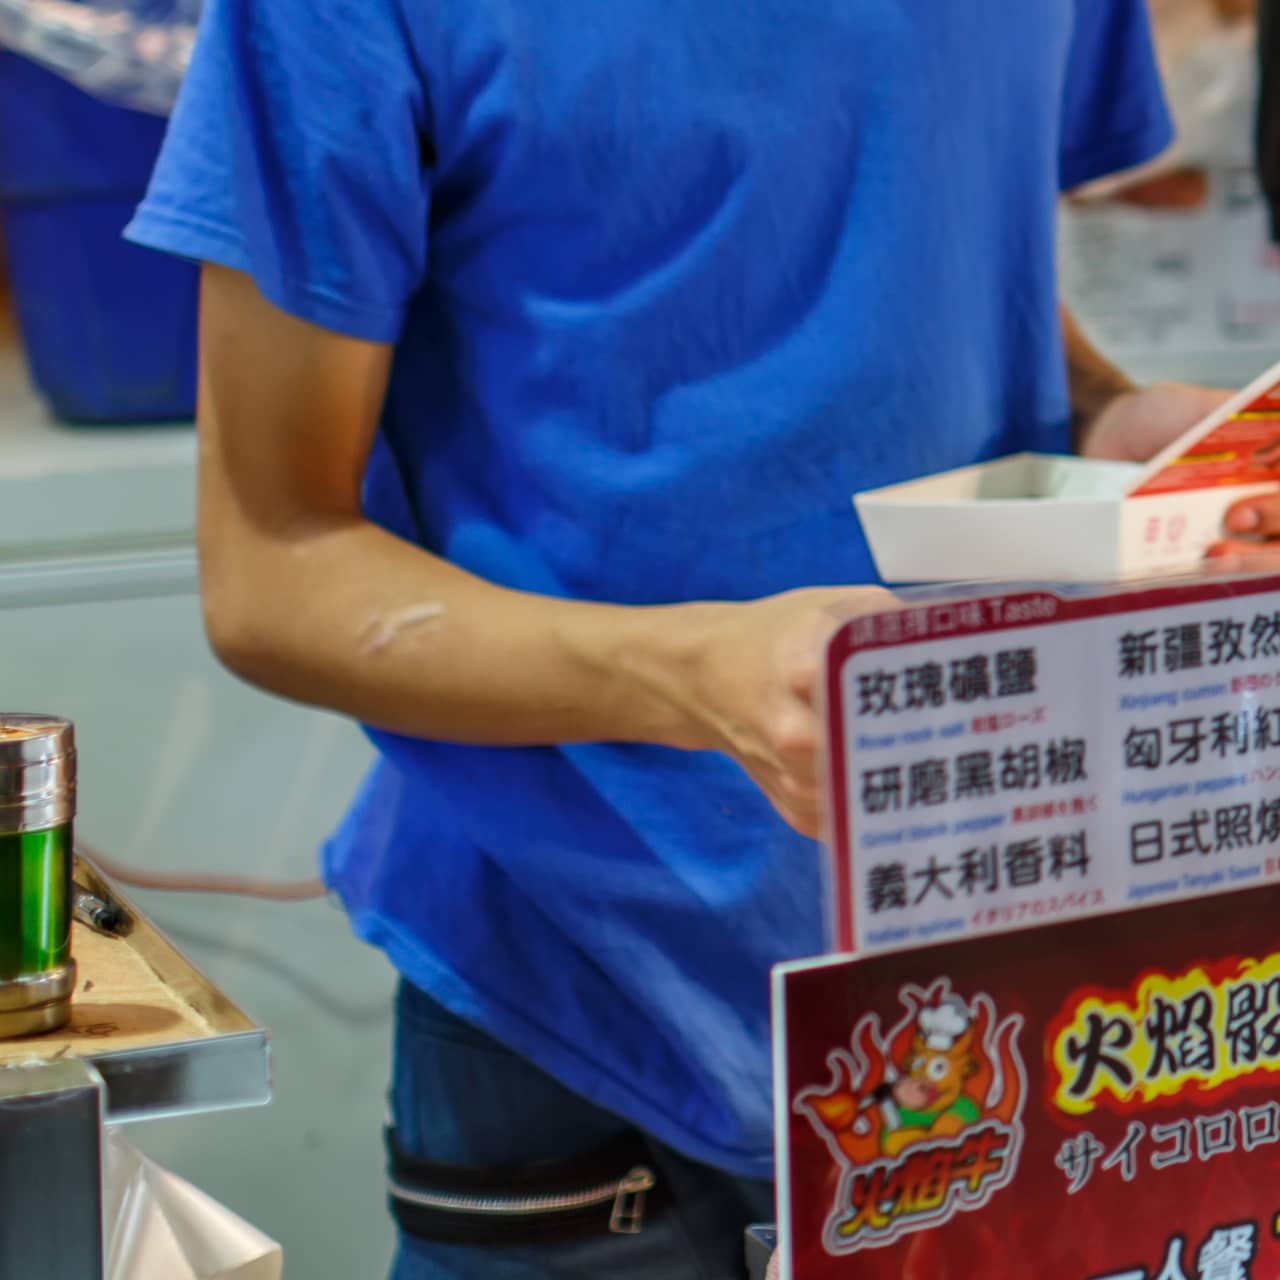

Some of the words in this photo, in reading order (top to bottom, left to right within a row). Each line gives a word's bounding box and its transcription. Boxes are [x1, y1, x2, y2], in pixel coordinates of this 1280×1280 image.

[989, 598, 1056, 624] Taste
[857, 646, 1036, 716] 玫瑰礦鹽
[861, 736, 1088, 814] 研磨黑胡椒
[868, 829, 1090, 914] 義大利香料
